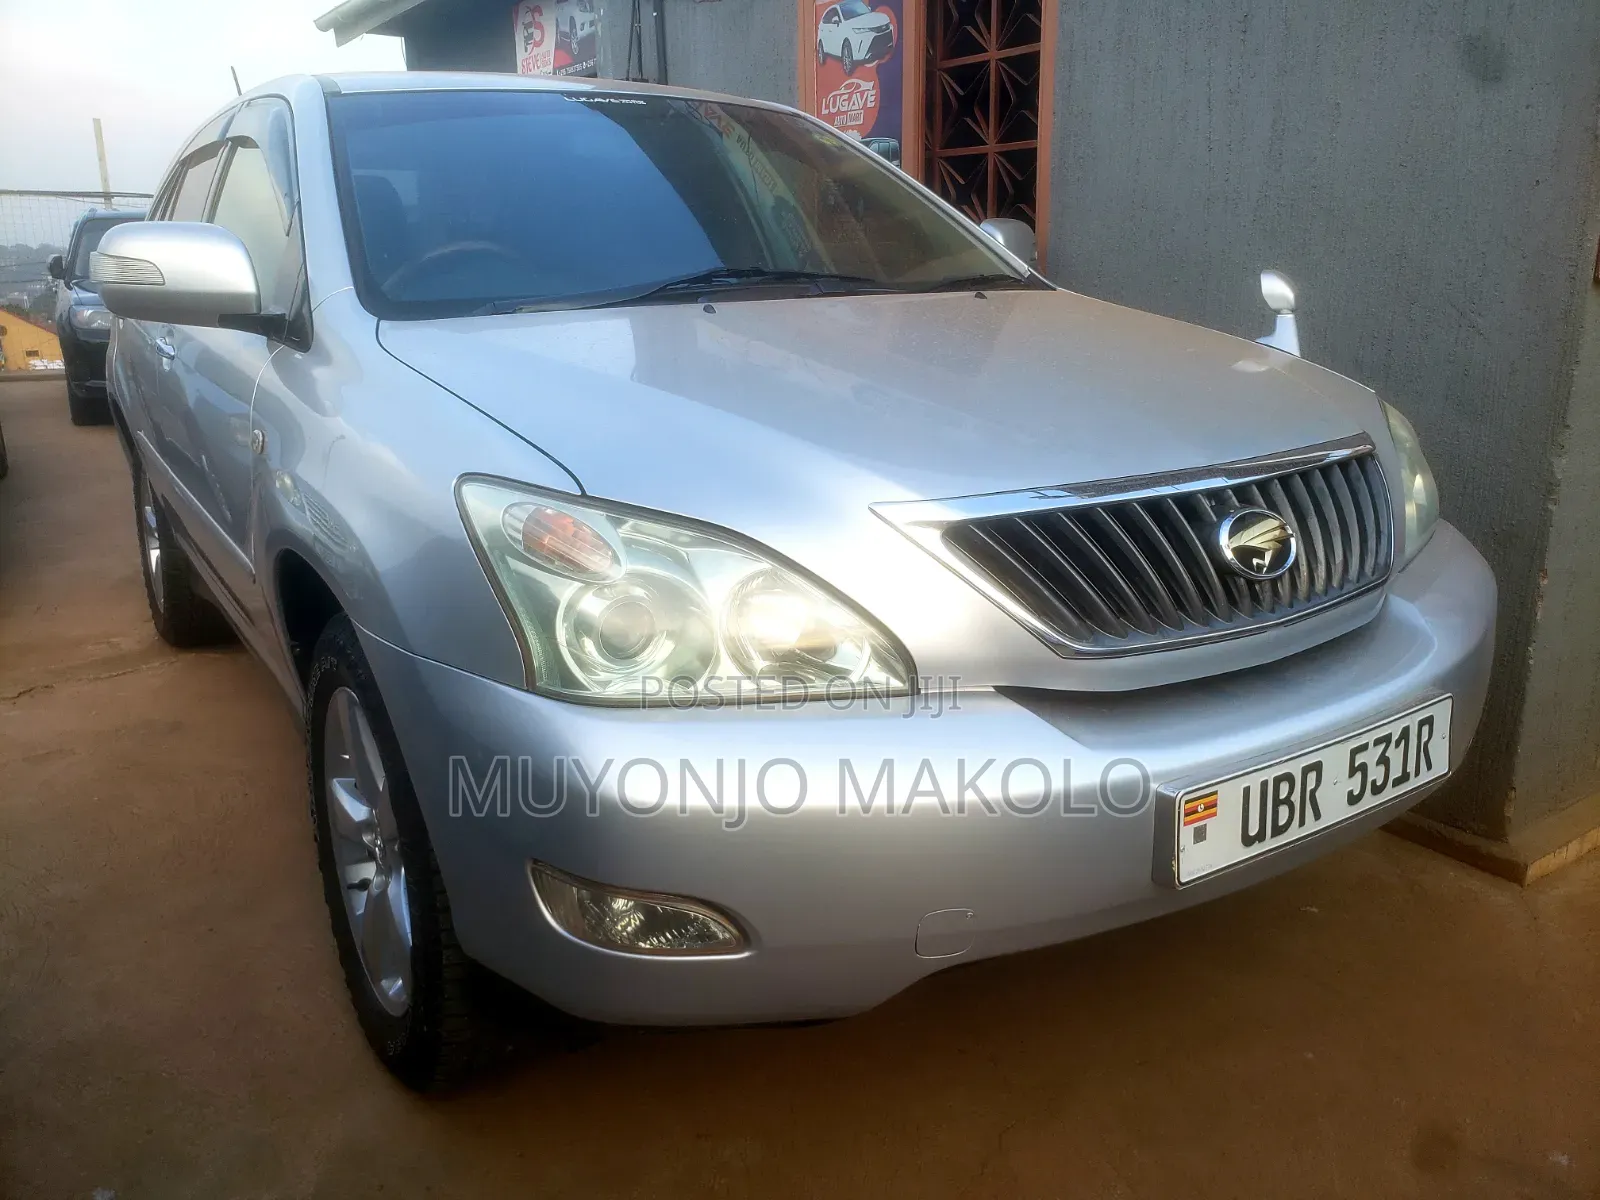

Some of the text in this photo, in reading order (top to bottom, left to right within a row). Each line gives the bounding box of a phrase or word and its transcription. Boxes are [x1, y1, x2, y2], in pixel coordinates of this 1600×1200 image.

[821, 89, 877, 115] LUGAVE
[1240, 713, 1434, 848] UBR 531R
